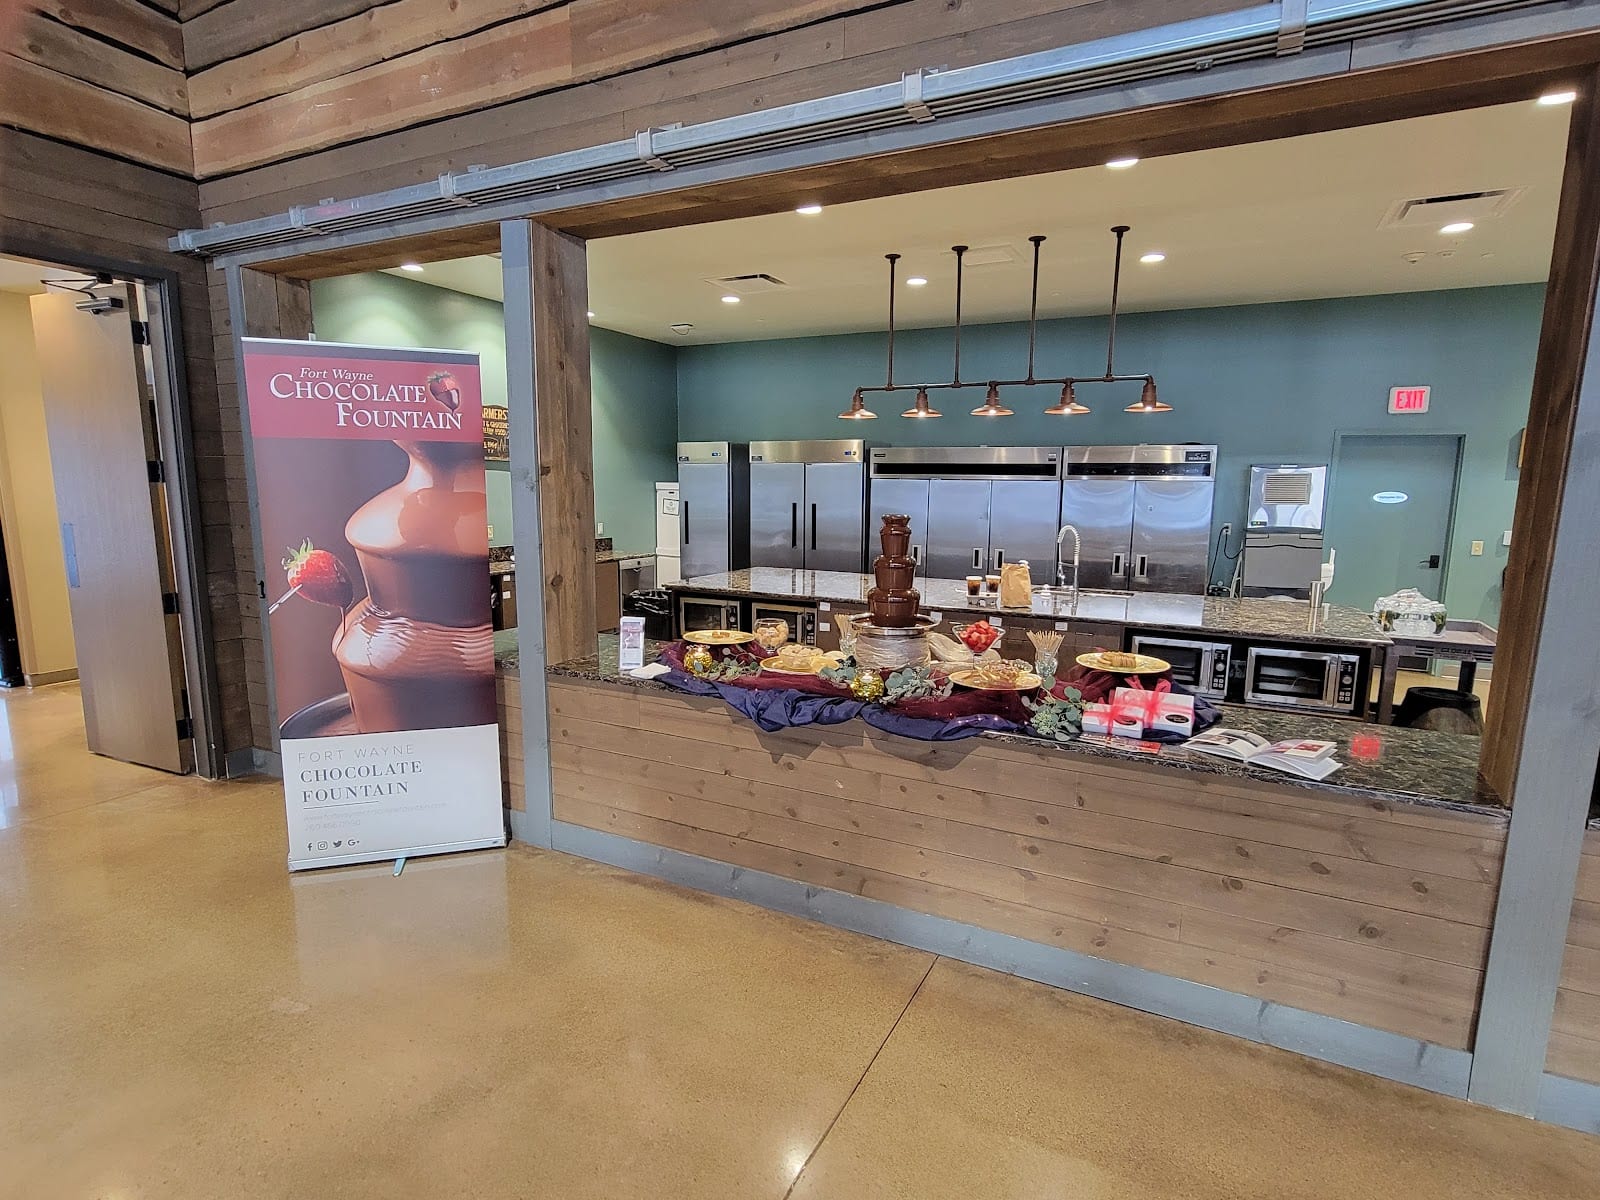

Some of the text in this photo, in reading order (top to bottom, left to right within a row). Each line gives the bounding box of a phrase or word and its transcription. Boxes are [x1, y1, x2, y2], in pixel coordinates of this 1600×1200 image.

[300, 367, 374, 383] Fort Wayne
[269, 373, 427, 404] CHOCOLATE
[1395, 390, 1425, 409] EXIT
[336, 402, 463, 430] FOUNTAIN
[298, 744, 415, 764] FORT WAYNE
[300, 760, 423, 783] CHOCOLATE
[301, 781, 409, 803] FOUNTAIN
